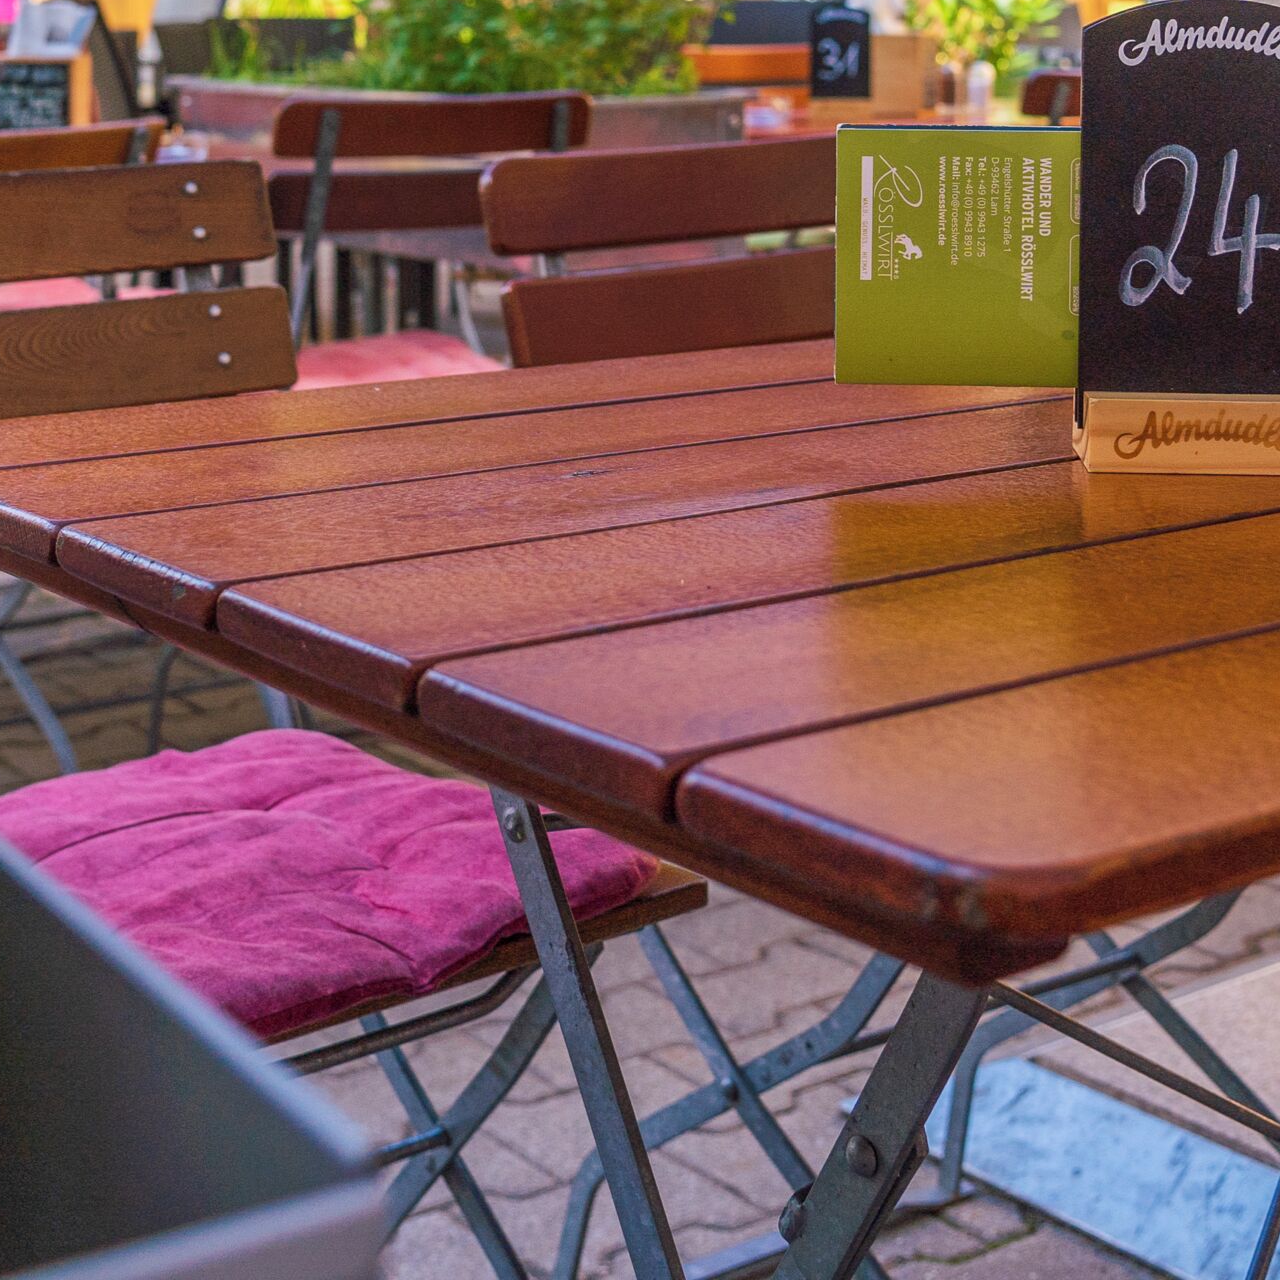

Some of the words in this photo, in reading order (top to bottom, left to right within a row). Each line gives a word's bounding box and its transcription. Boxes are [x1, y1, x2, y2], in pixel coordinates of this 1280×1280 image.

[952, 157, 960, 180] Mail:
[965, 157, 973, 175] Fax:
[978, 157, 986, 176] Tel.:
[990, 157, 999, 194] D-93462
[964, 179, 972, 194] +49
[977, 179, 985, 195] +49
[1002, 158, 1012, 213] Engelshütter
[1039, 158, 1052, 207] WANDER
[938, 156, 947, 246] www.roesslwirt.de
[963, 197, 973, 208] (0)
[976, 198, 986, 209] (0)
[1021, 158, 1034, 231] AKTIVHOTEL
[990, 197, 999, 215] Lam
[950, 182, 959, 265] info@roesslwirt.de
[964, 211, 972, 232] 9943
[977, 211, 985, 233] 9943
[1003, 216, 1012, 245] Straße
[1039, 212, 1051, 236] UND
[964, 235, 972, 257] 8910
[977, 236, 985, 257] 1275
[1021, 235, 1036, 301] RÖSSLWIRT
